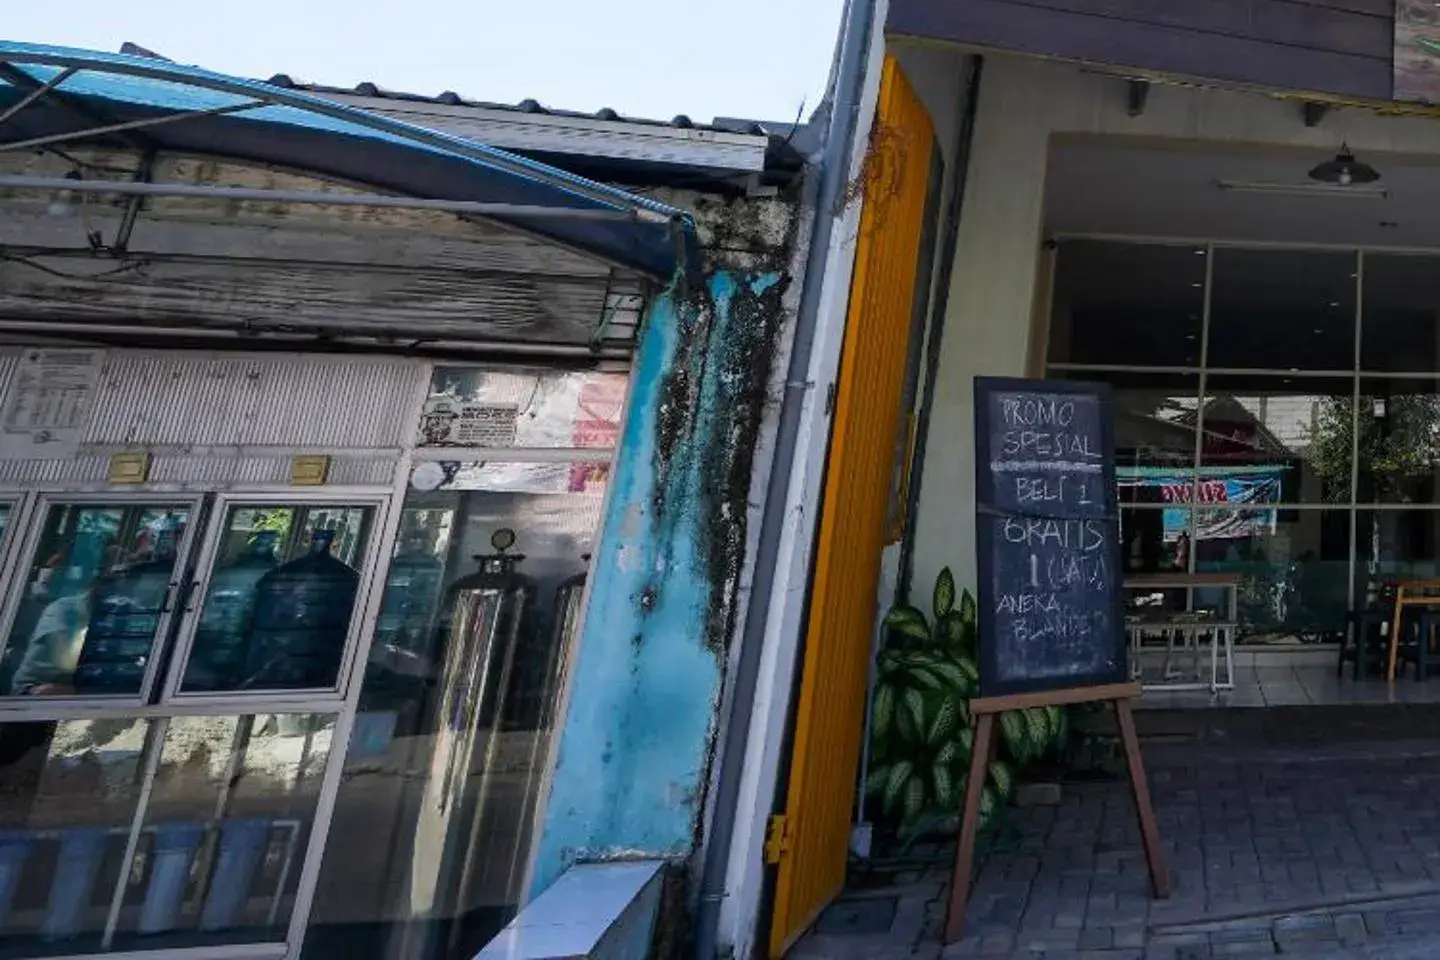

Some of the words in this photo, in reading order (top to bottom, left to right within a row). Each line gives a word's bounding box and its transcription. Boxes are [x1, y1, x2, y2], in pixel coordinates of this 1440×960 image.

[1002, 398, 1074, 427] PROMO
[1003, 432, 1102, 458] SPESIAL
[1003, 517, 1104, 551] GRATIS
[996, 592, 1060, 613] ANEKA
